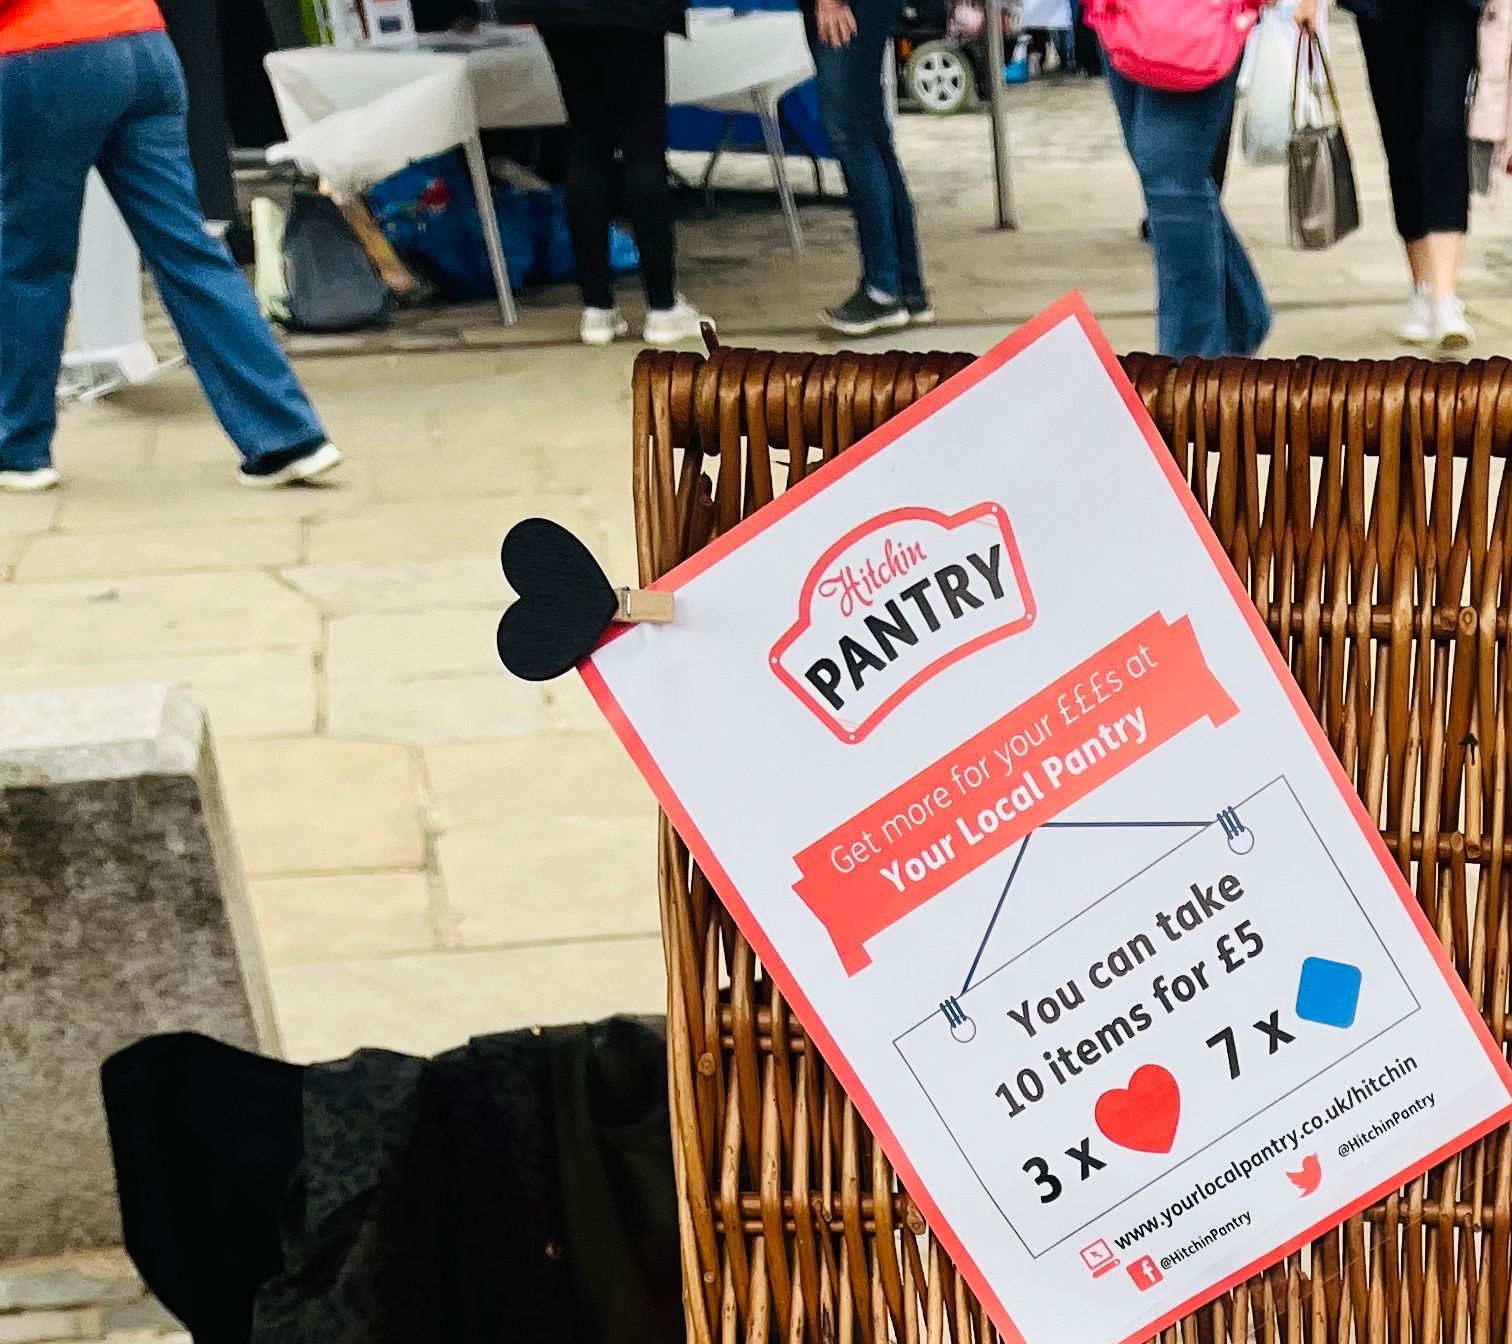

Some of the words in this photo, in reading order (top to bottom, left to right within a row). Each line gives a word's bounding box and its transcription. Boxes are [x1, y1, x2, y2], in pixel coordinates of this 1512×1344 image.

[805, 544, 1004, 710] PANTRY
[819, 539, 927, 616] Hitchin
[830, 829, 882, 874] Get
[882, 787, 953, 844] more
[951, 756, 991, 798] for
[993, 713, 1053, 776] your
[1057, 667, 1124, 726] £££s
[1125, 644, 1159, 680] at
[879, 838, 957, 893] Your
[955, 771, 1046, 848] Local
[1040, 706, 1148, 789] Pantry
[994, 1068, 1045, 1118] 10
[1043, 1004, 1153, 1085] items
[1153, 961, 1210, 1014] for
[1216, 919, 1264, 974] £5
[1007, 979, 1086, 1039] You
[1088, 933, 1157, 989] can
[1156, 874, 1245, 942] take
[1205, 1026, 1241, 1080] 7
[1253, 1009, 1296, 1055] x
[1338, 1092, 1436, 1158] @HitchinPantry
[1022, 1156, 1063, 1204] 3
[1065, 1136, 1107, 1181] x
[1114, 1055, 1418, 1251] www.yourlocalpantry.co.uk/hitchin
[1160, 1211, 1252, 1271] @HitchinPantry
